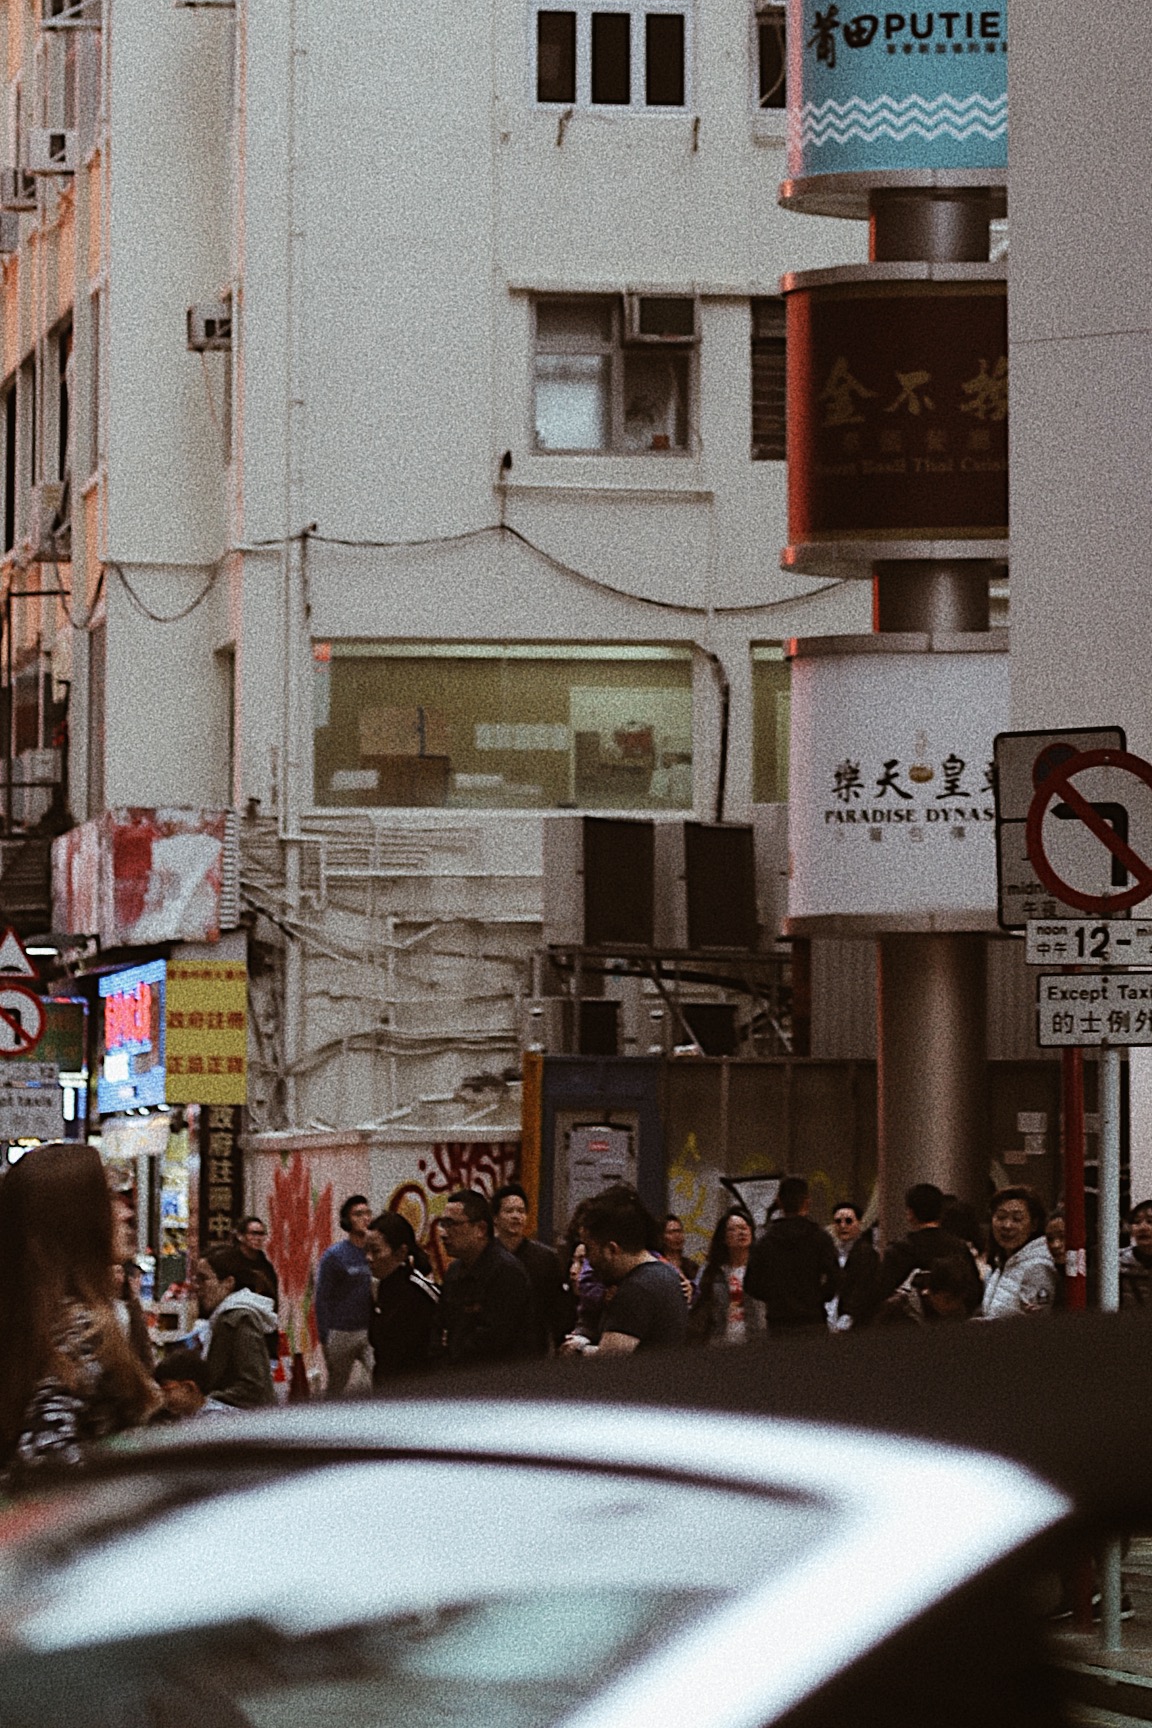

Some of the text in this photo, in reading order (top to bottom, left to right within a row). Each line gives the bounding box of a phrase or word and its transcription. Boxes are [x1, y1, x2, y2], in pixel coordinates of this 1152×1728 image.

[884, 11, 1001, 40] PUTIE
[824, 805, 995, 824] PARADISE DYNAS
[1036, 924, 1068, 936] noon
[1074, 926, 1110, 958] 12
[1036, 941, 1067, 955] 中午
[1047, 984, 1108, 1003] Except
